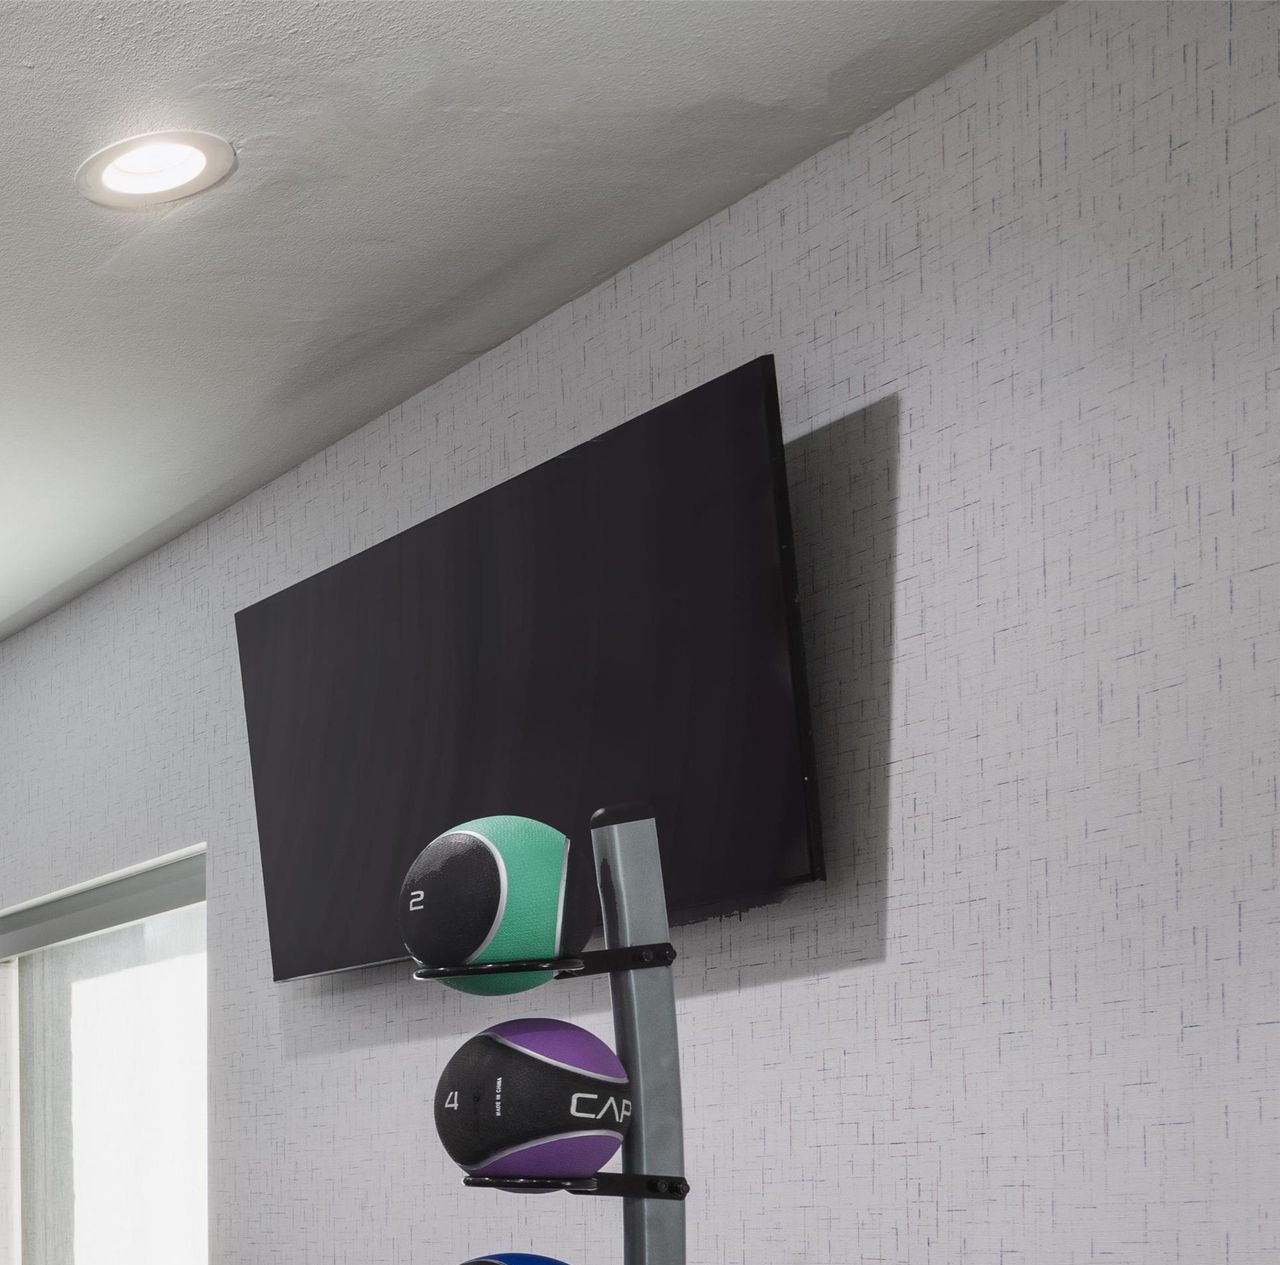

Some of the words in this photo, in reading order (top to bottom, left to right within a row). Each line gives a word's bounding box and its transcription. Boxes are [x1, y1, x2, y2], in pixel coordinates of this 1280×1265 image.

[408, 890, 425, 912] 2
[444, 1091, 460, 1111] 4
[570, 1092, 633, 1123] CAP
